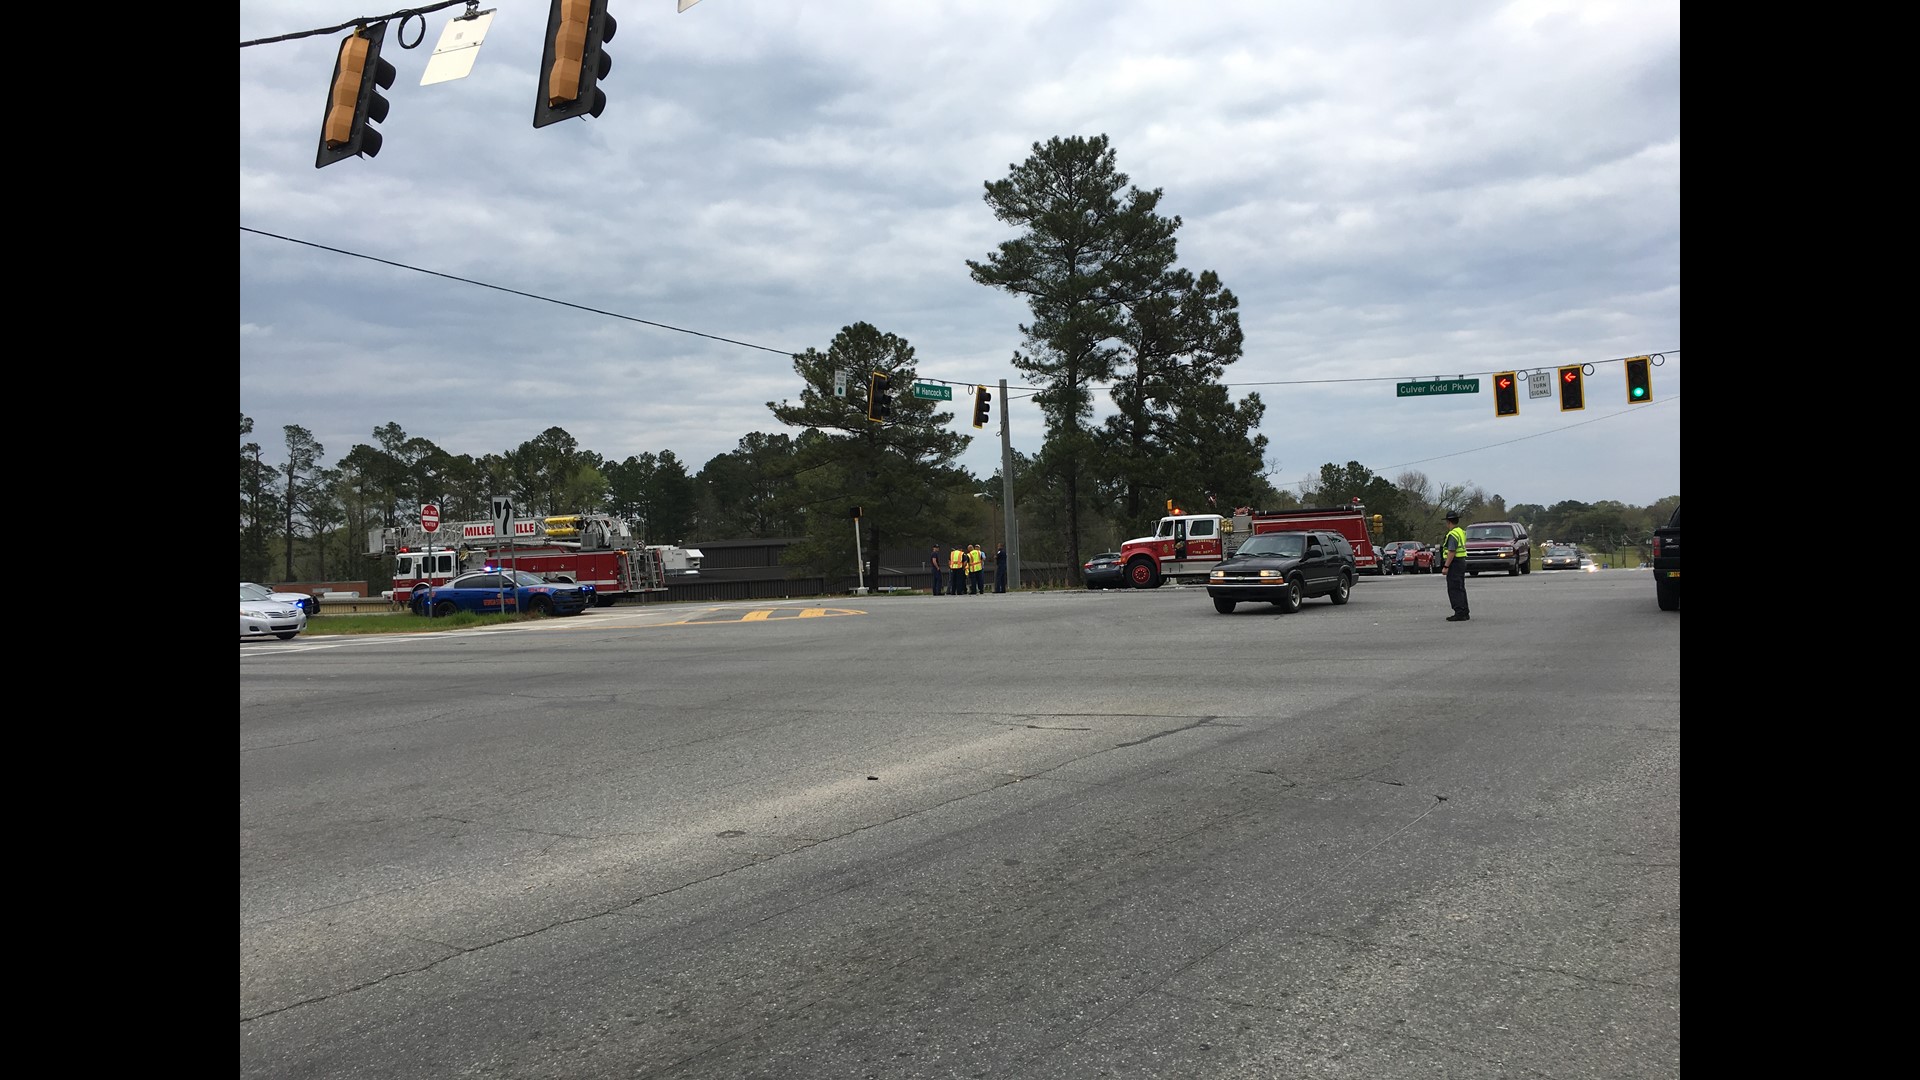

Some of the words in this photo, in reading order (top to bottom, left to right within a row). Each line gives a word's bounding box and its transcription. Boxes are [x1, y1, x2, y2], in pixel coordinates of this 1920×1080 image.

[915, 386, 920, 394] W
[921, 387, 942, 397] Hancock
[944, 390, 950, 398] St
[1400, 385, 1426, 394] Culver
[1429, 383, 1448, 392] Kidd
[1452, 383, 1475, 392] Pkwy
